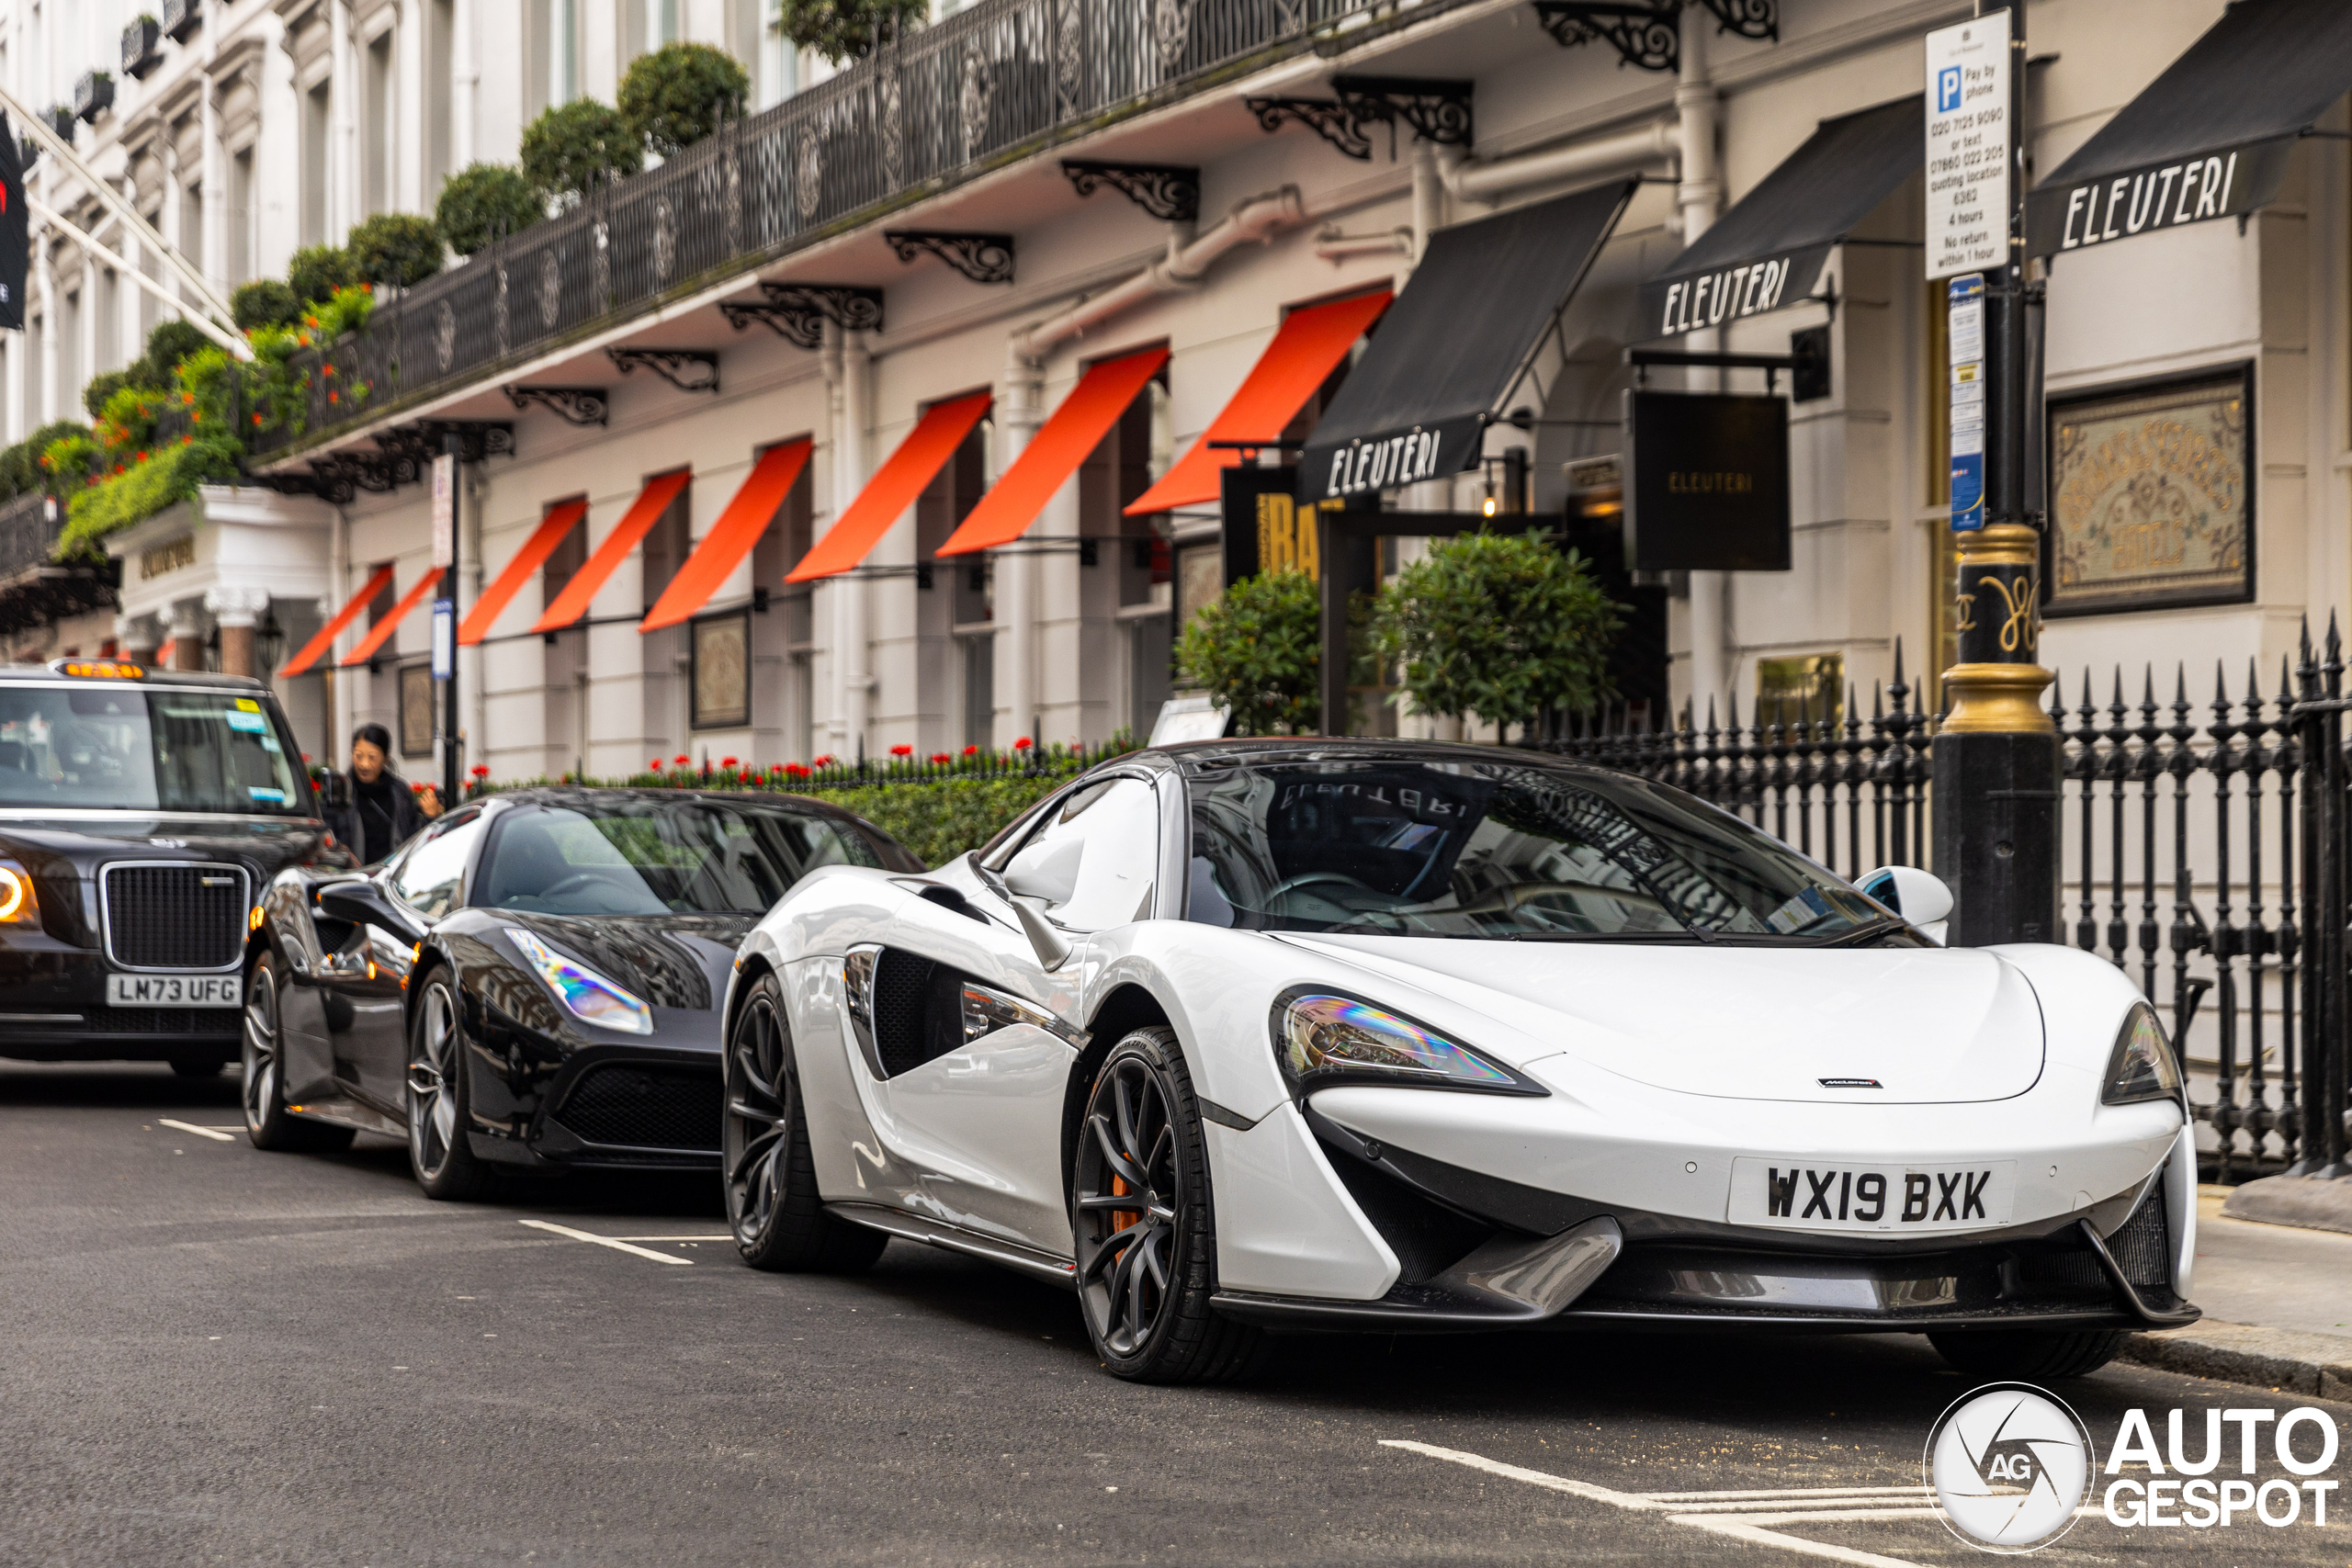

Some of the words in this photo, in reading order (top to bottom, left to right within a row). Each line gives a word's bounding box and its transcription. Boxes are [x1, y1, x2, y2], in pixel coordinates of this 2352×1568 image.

[1965, 68, 1981, 81] Pay
[1984, 64, 1996, 78] by
[1966, 83, 1994, 101] phone
[1931, 120, 1950, 138] 020
[1953, 113, 1973, 131] 7125
[1977, 107, 2003, 125] 9090
[1951, 140, 1960, 151] or
[1963, 133, 1982, 147] text
[1963, 150, 1983, 166] 022
[1984, 144, 2004, 161] 205
[1931, 175, 1963, 193] quoting
[1967, 165, 2004, 184] location
[2062, 152, 2237, 249] ELEUTERI
[1950, 212, 1955, 226] 4
[1958, 209, 1983, 225] hours
[1945, 235, 1957, 249] No
[1960, 231, 1988, 245] return
[1939, 253, 1965, 269] within
[1974, 247, 1995, 259] hour
[1662, 257, 1791, 336] ELEUTERI
[1327, 429, 1441, 497] ELEUTERI
[1668, 471, 1752, 494] ELEUTERI
[119, 978, 182, 1001] LM73
[189, 978, 235, 1001] UFG
[1769, 1168, 1887, 1222] WX19
[1901, 1170, 1991, 1222] BXK
